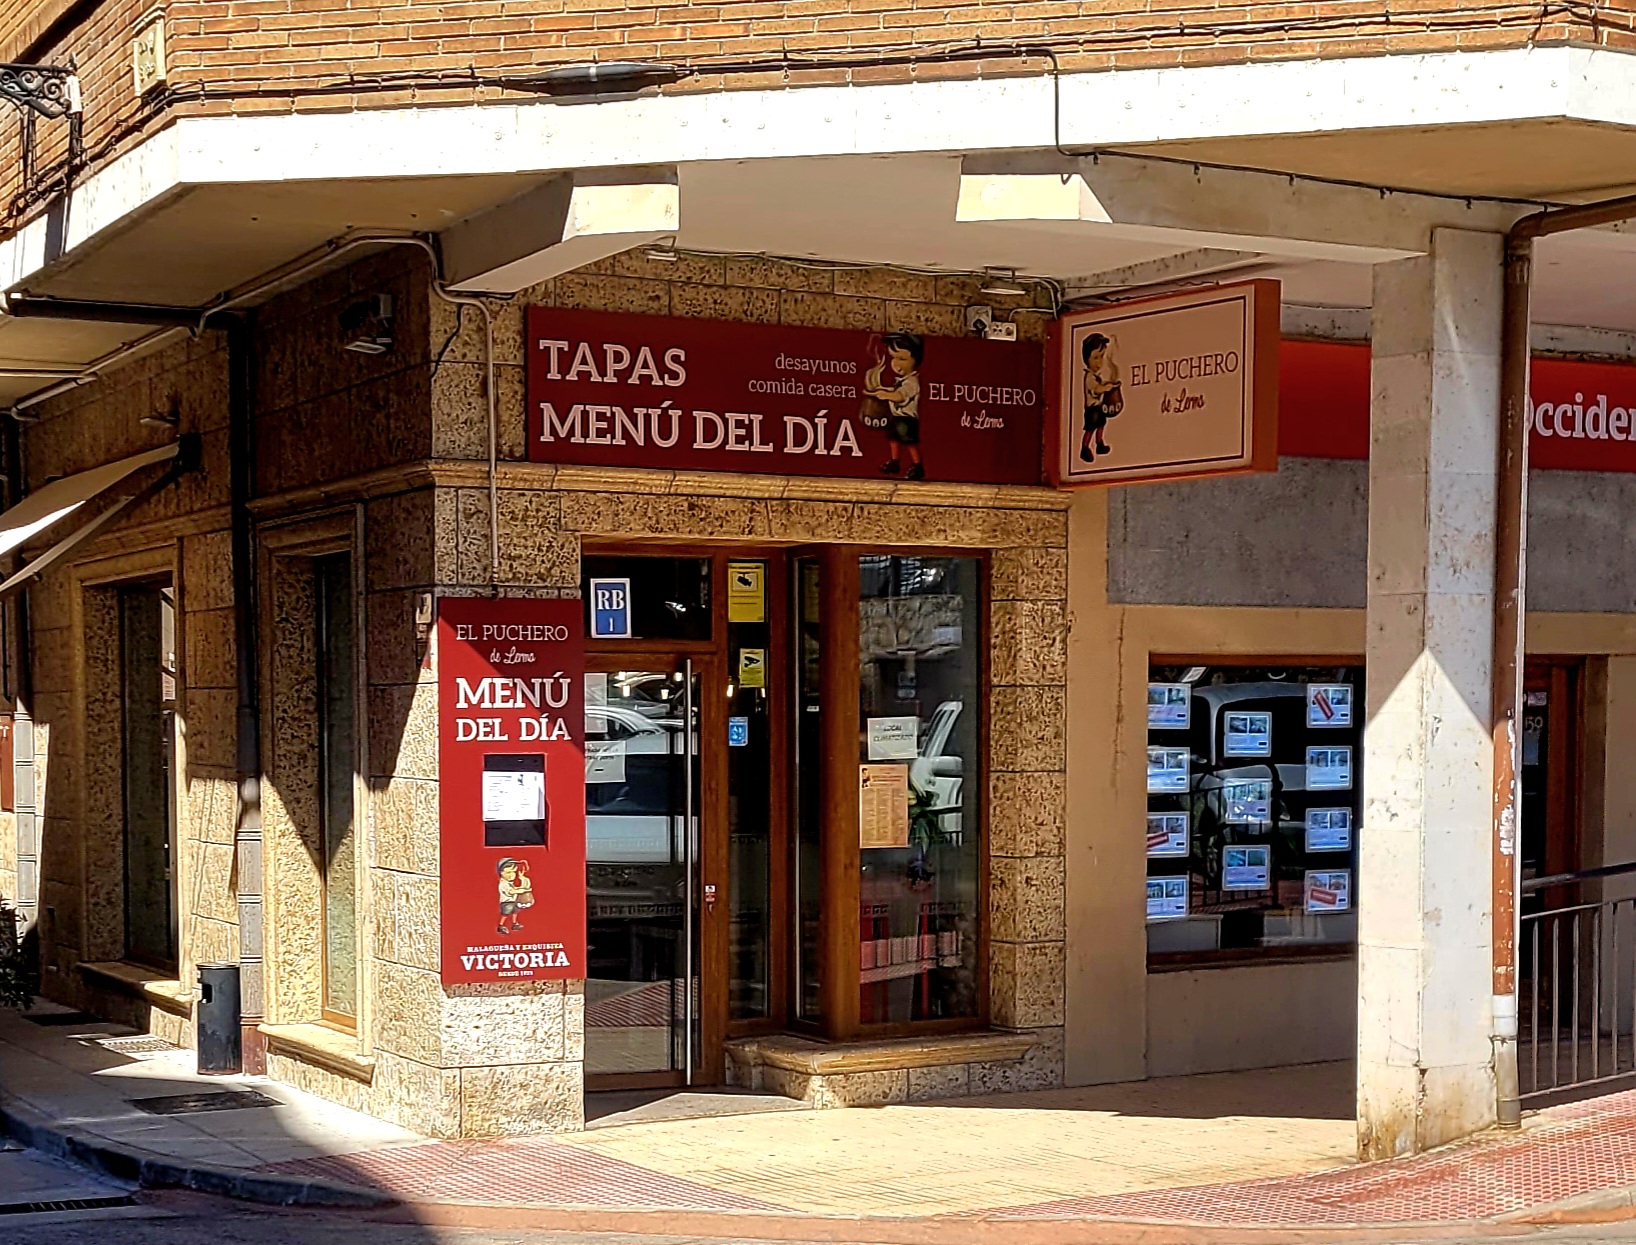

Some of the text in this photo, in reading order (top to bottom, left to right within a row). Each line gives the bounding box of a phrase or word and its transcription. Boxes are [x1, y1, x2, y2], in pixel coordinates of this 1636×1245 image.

[539, 339, 686, 387] TAPAS
[775, 352, 857, 376] desayunos
[1130, 351, 1239, 387] EL PUCHERO
[748, 378, 857, 398] comida casera
[928, 383, 1036, 406] EL PUCHERO
[1161, 392, 1171, 414] de
[961, 410, 971, 428] de
[1529, 391, 1636, 442] ccide
[539, 400, 863, 457] MENÚ DEL DÍA
[597, 589, 625, 610] RB
[456, 624, 569, 641] EL PUCHERO
[490, 647, 501, 663] de
[455, 671, 571, 709] MENÚ
[456, 713, 572, 741] DEL DÍA
[460, 951, 571, 971] VICTORIA
